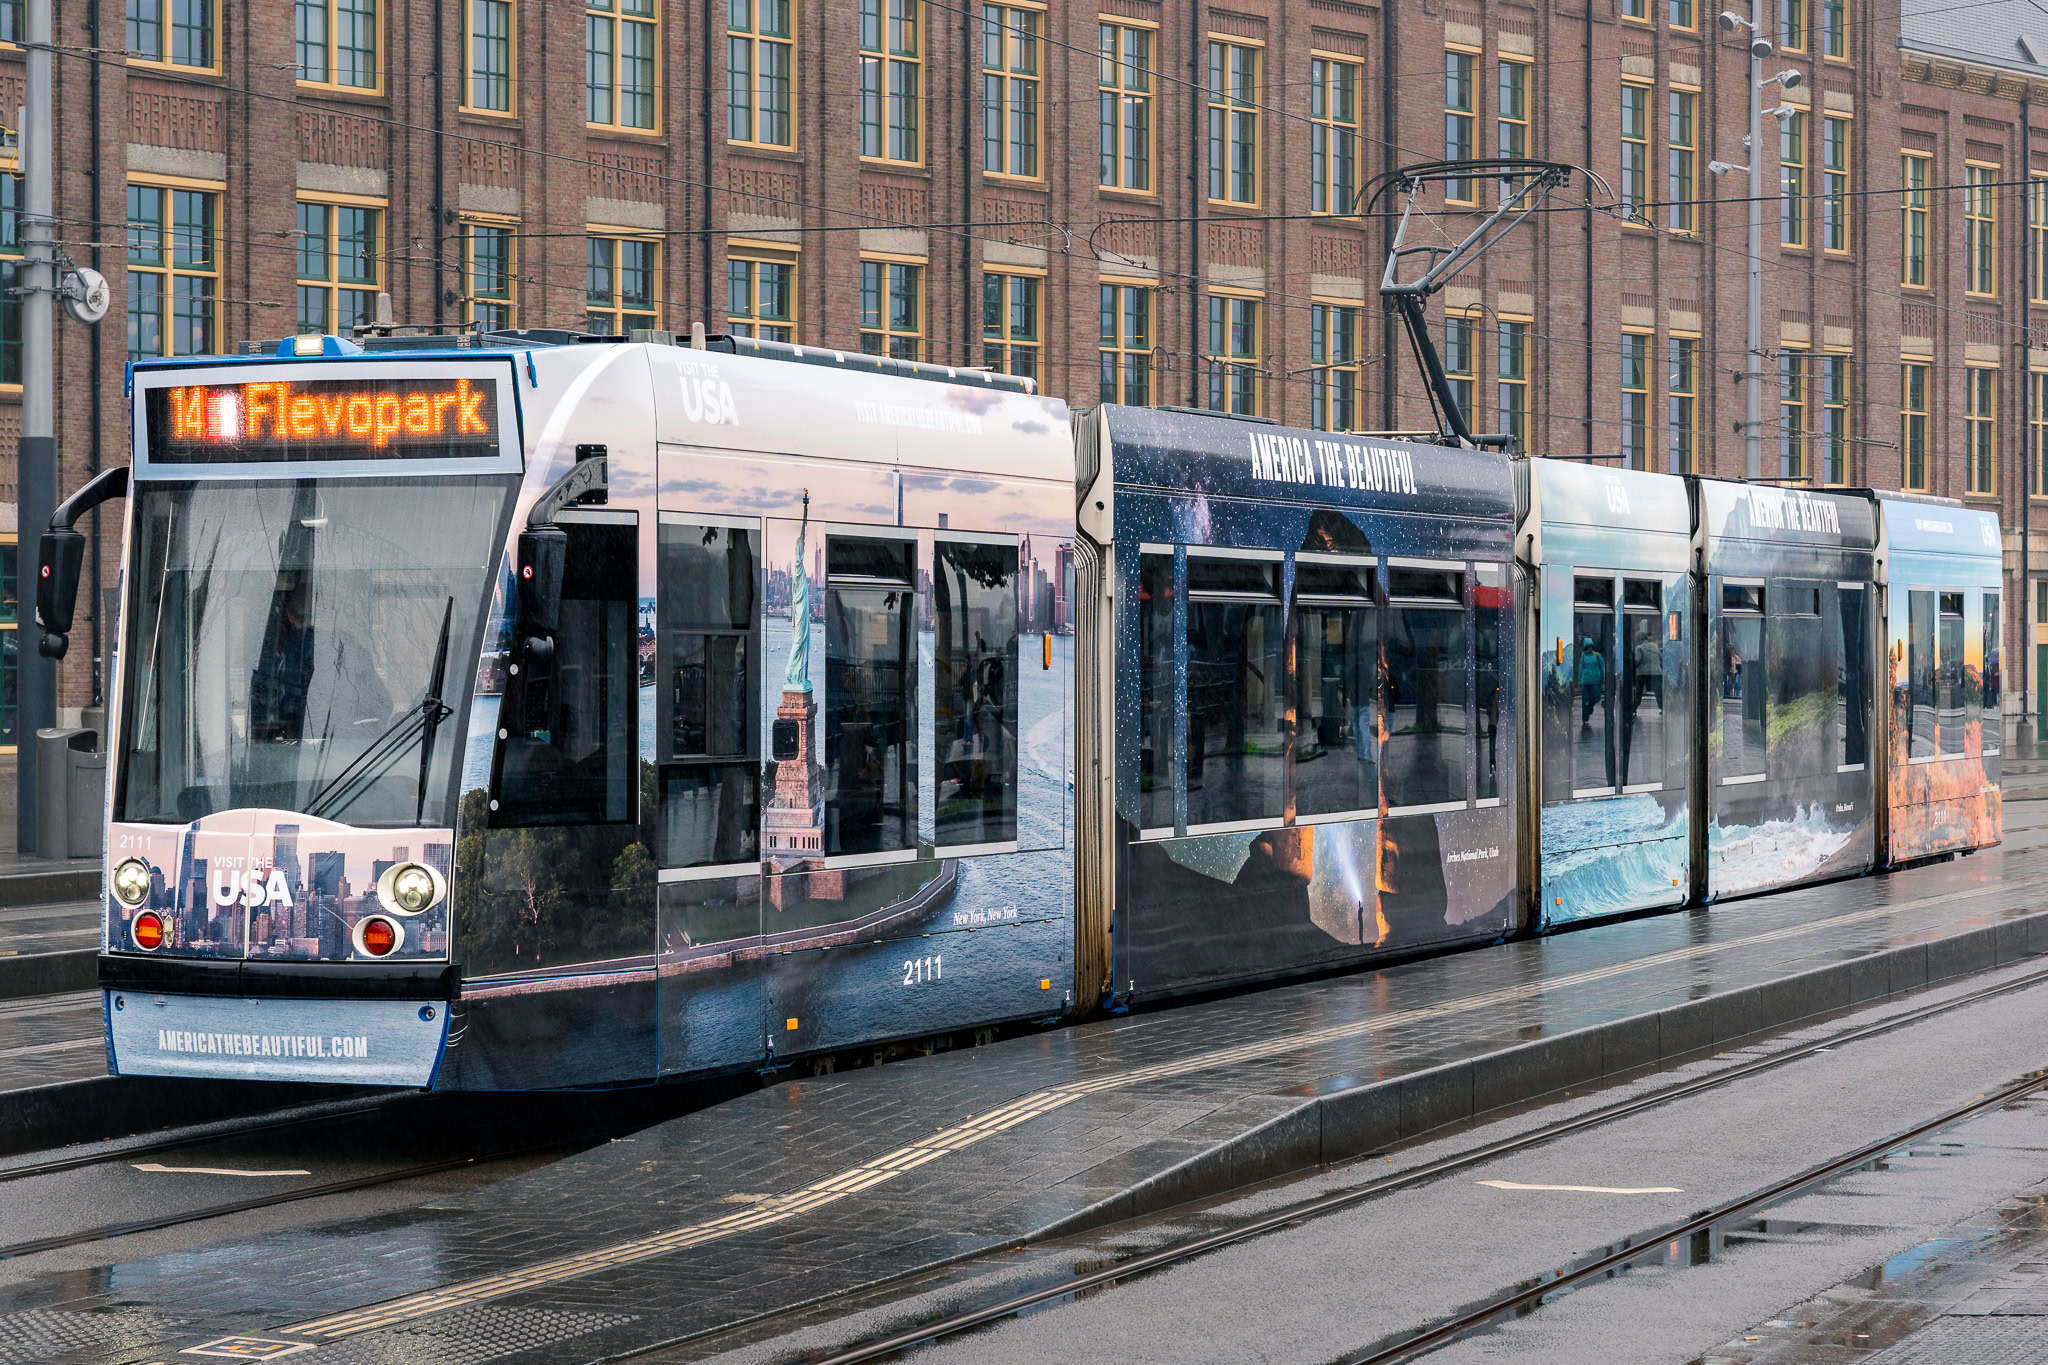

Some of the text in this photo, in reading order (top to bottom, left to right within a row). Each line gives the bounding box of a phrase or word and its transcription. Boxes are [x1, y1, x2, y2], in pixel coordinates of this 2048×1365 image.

[676, 360, 719, 378] VISIT THE
[170, 379, 487, 448] 14 Flevopark
[680, 376, 739, 426] USA
[854, 400, 878, 424] VISIT
[1249, 432, 1417, 495] AMERICA THE BEAUTIFUL
[1605, 484, 1631, 514] USA
[1783, 496, 1800, 531] THE
[1799, 497, 1840, 534] BEAUTIFUL
[1934, 809, 1947, 825] 2111
[119, 834, 151, 850] 2111
[214, 856, 244, 869] VISIT
[213, 869, 293, 907] USA
[953, 904, 1017, 925] New York, New York
[903, 955, 942, 985] 2111
[159, 1030, 368, 1058] AMERICATHEBEAUTIFUL.COM
